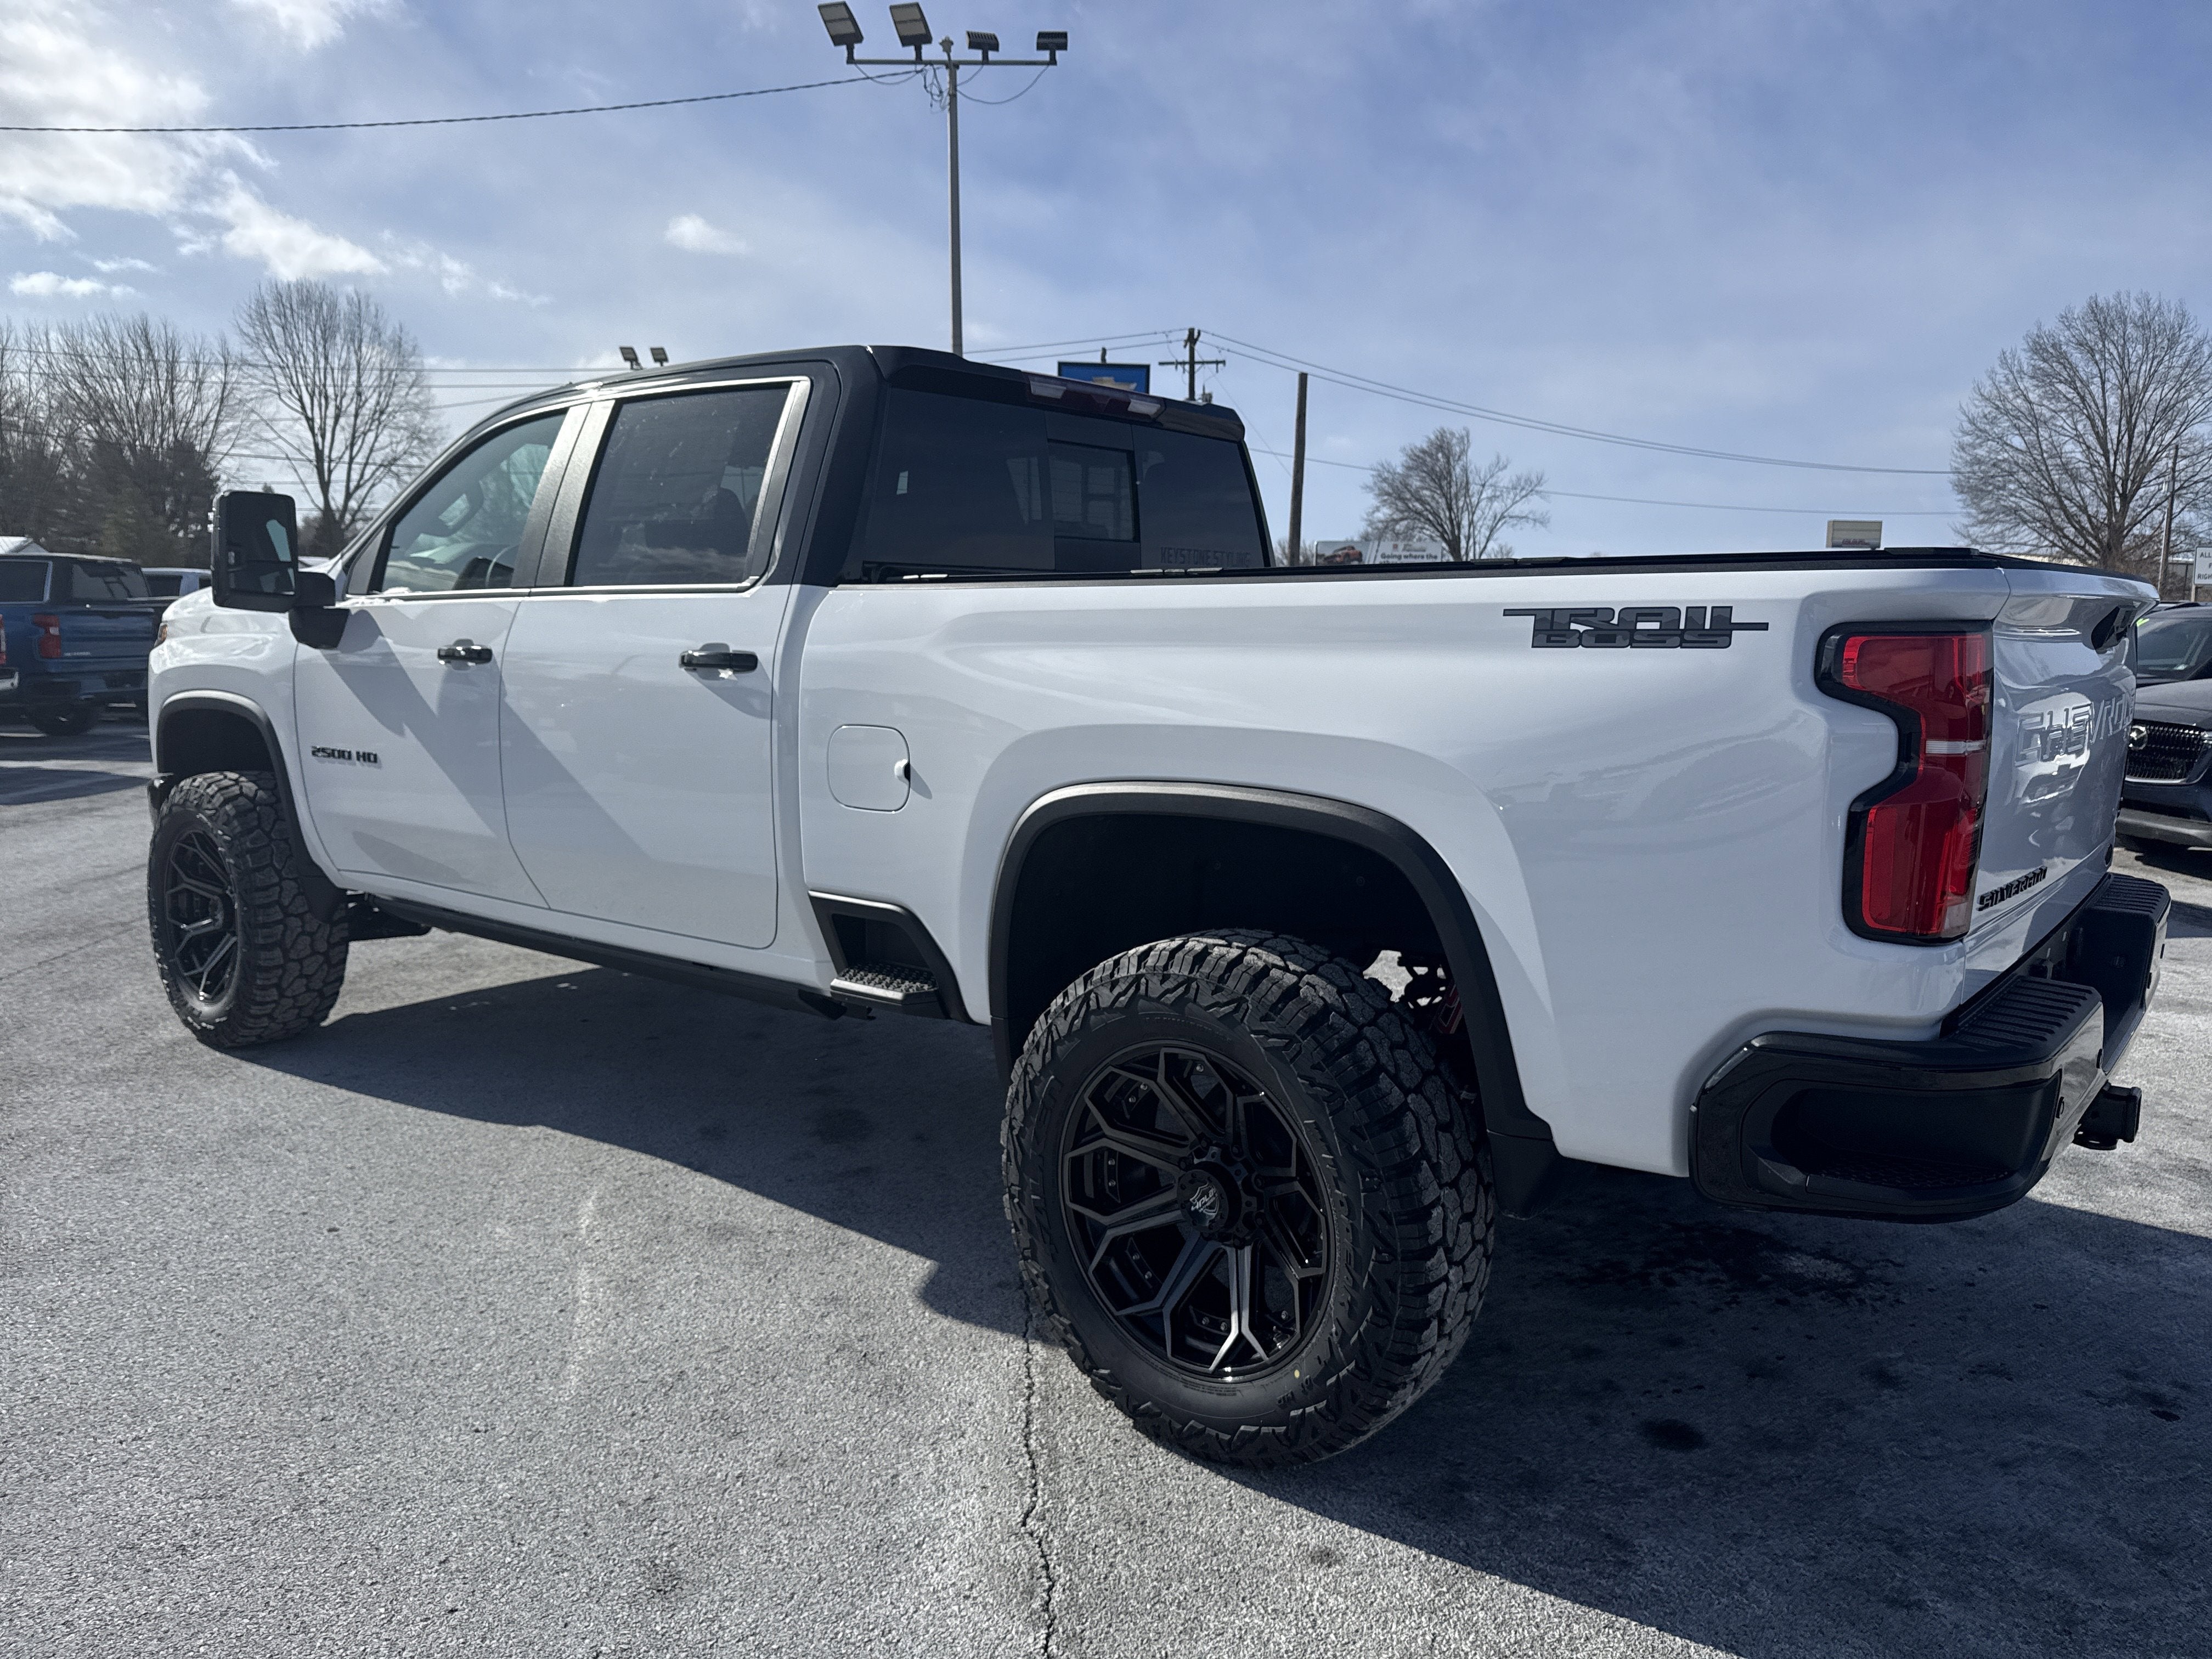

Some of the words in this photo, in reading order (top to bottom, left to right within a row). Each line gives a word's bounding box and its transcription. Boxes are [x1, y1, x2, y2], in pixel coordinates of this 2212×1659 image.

[1380, 552, 1402, 560] Going
[1503, 606, 1769, 630] TRAIL
[1531, 629, 1732, 649] BOSS
[311, 745, 352, 761] 2500
[356, 749, 378, 764] HD
[1976, 865, 2048, 911] SILVERADO
